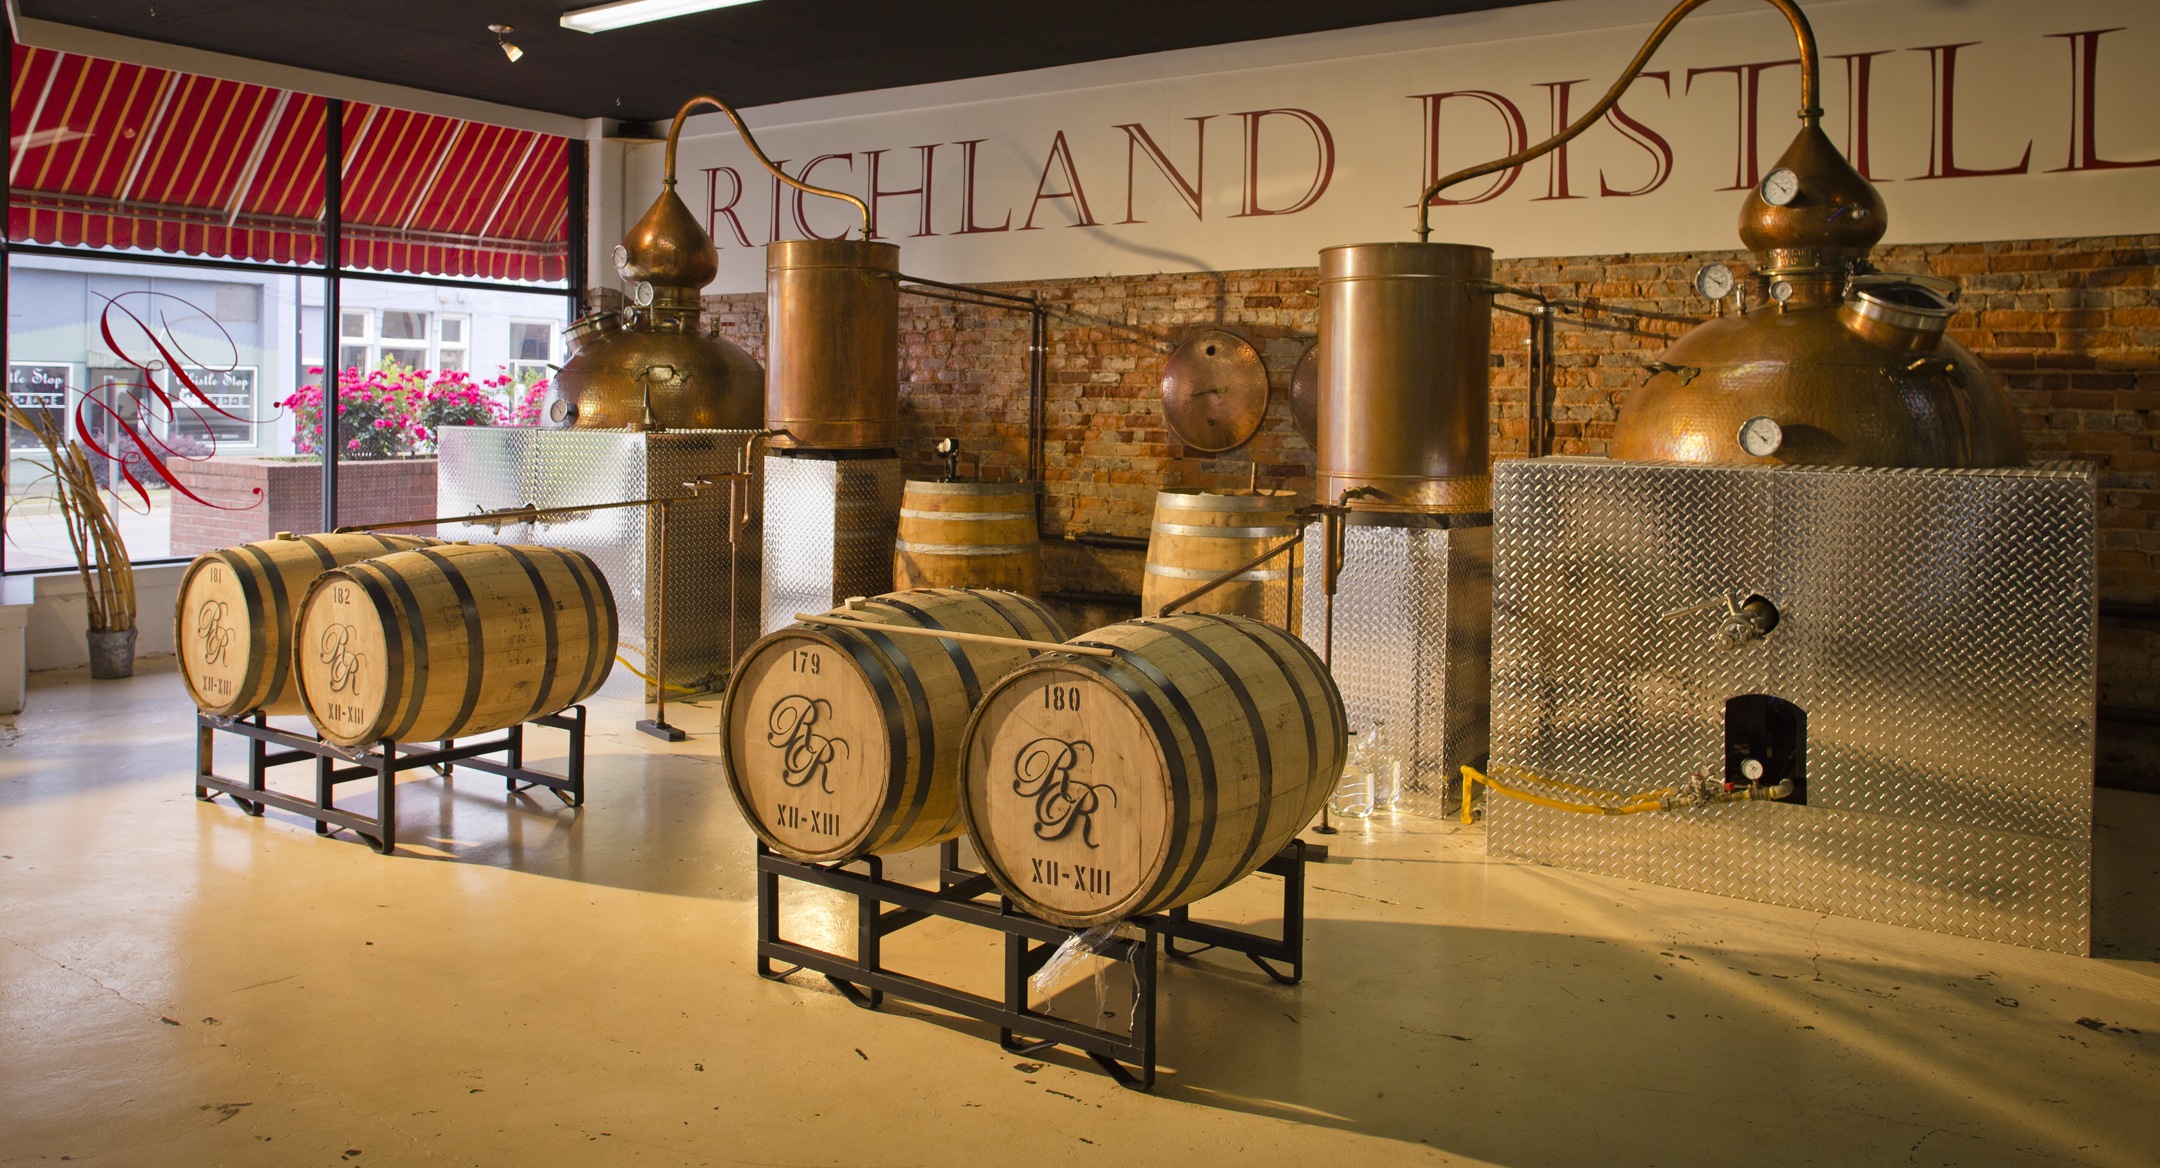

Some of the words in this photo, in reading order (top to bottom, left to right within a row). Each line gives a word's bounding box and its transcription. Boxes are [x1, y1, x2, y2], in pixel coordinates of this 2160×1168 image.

[698, 107, 1336, 250] RICHLAND
[1404, 26, 2160, 209] DISTILL
[31, 368, 64, 390] Stop
[222, 371, 249, 391] Stop
[210, 566, 222, 584] 181
[333, 586, 351, 605] 182
[791, 650, 821, 675] 179
[1044, 685, 1081, 712] 180
[328, 703, 365, 725] XII-XIII
[776, 803, 841, 837] XII-XIII
[1031, 858, 1111, 896] XII-XIII
